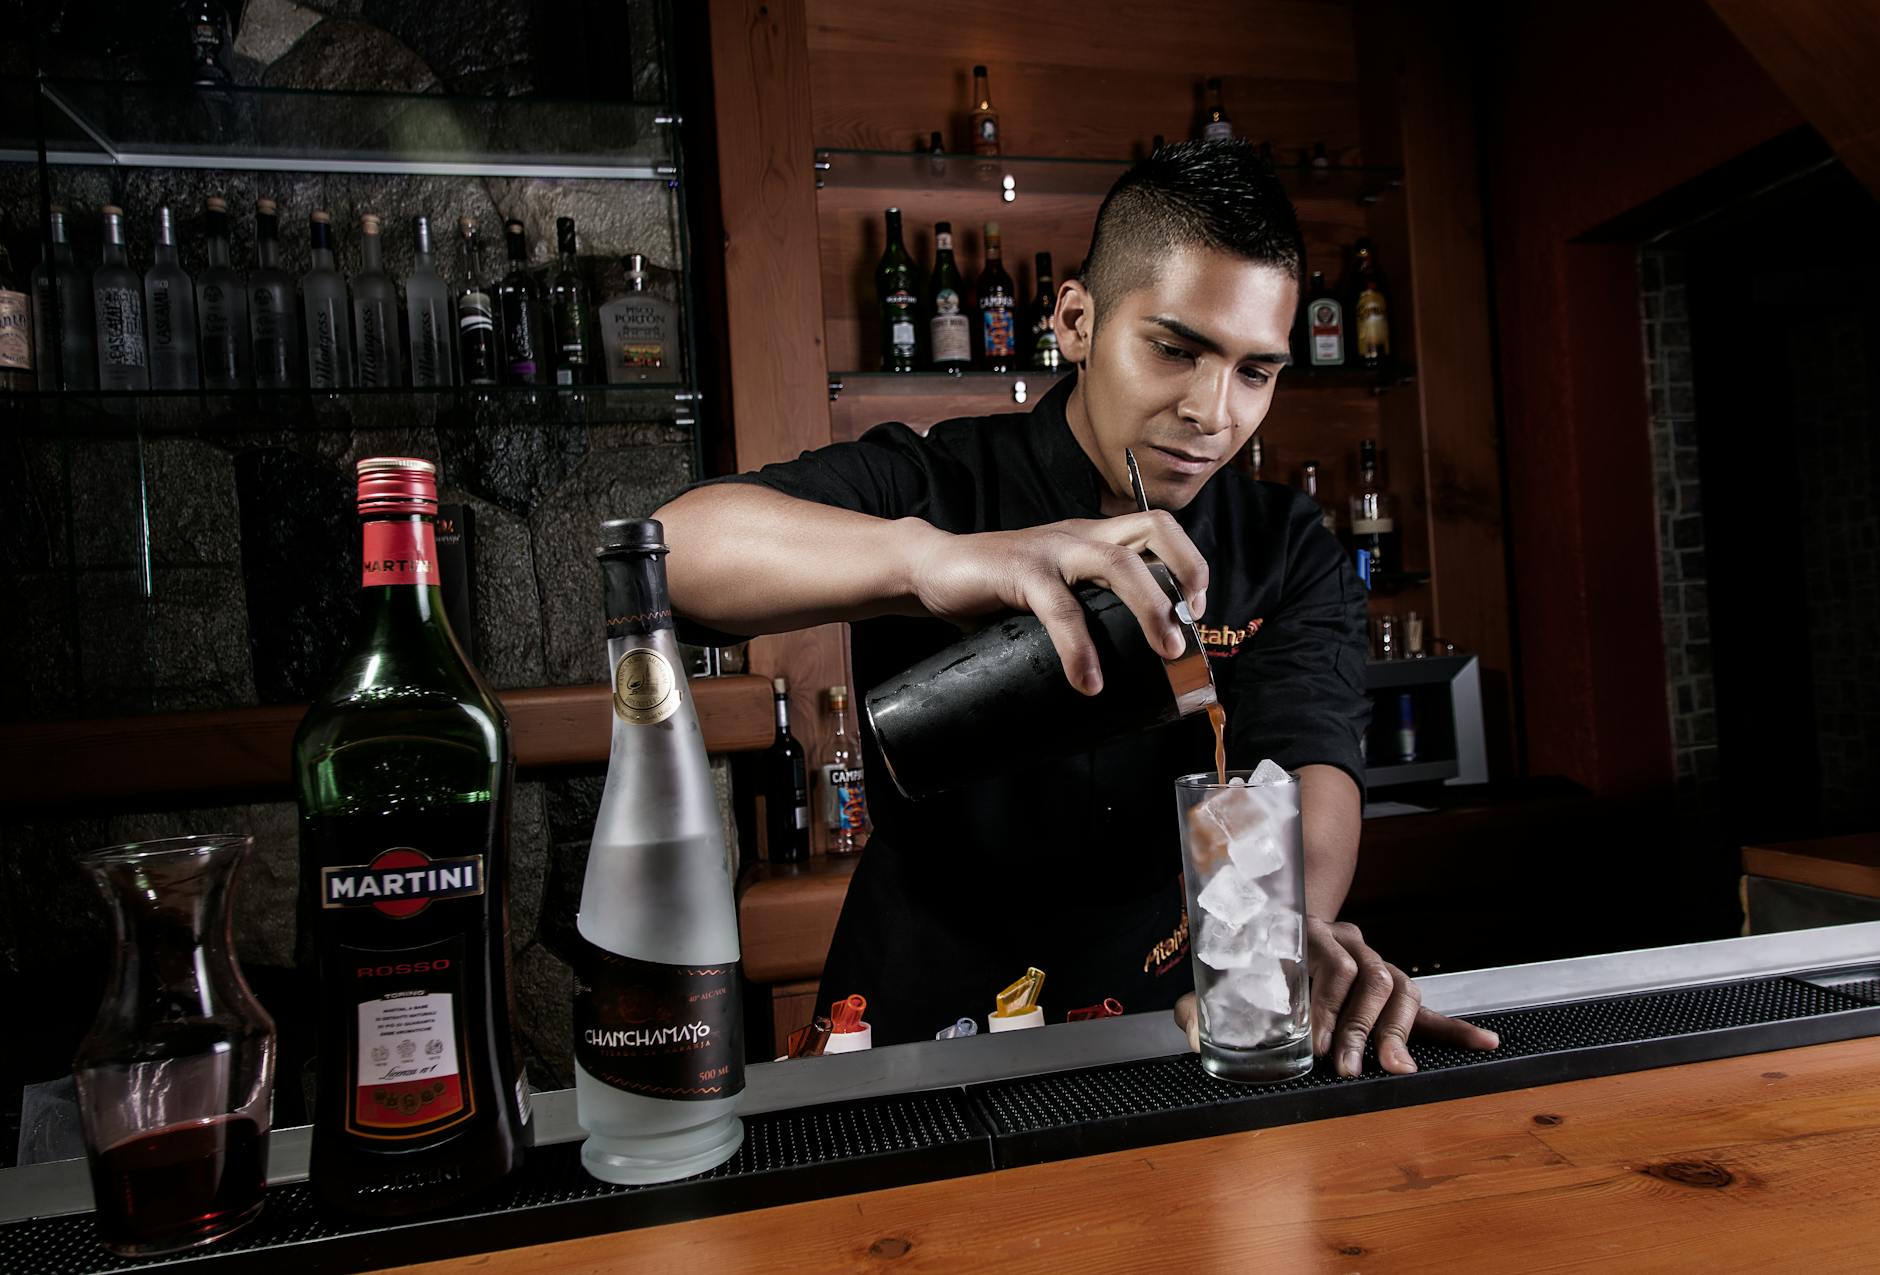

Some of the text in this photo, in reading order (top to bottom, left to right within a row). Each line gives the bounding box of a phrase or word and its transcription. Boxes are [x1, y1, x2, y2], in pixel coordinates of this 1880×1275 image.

[364, 559, 432, 574] MARTII
[332, 866, 473, 898] MARTINI
[357, 960, 450, 977] ROSSO
[585, 1020, 711, 1047] CHANCHAMAYO
[699, 1070, 716, 1082] 500
